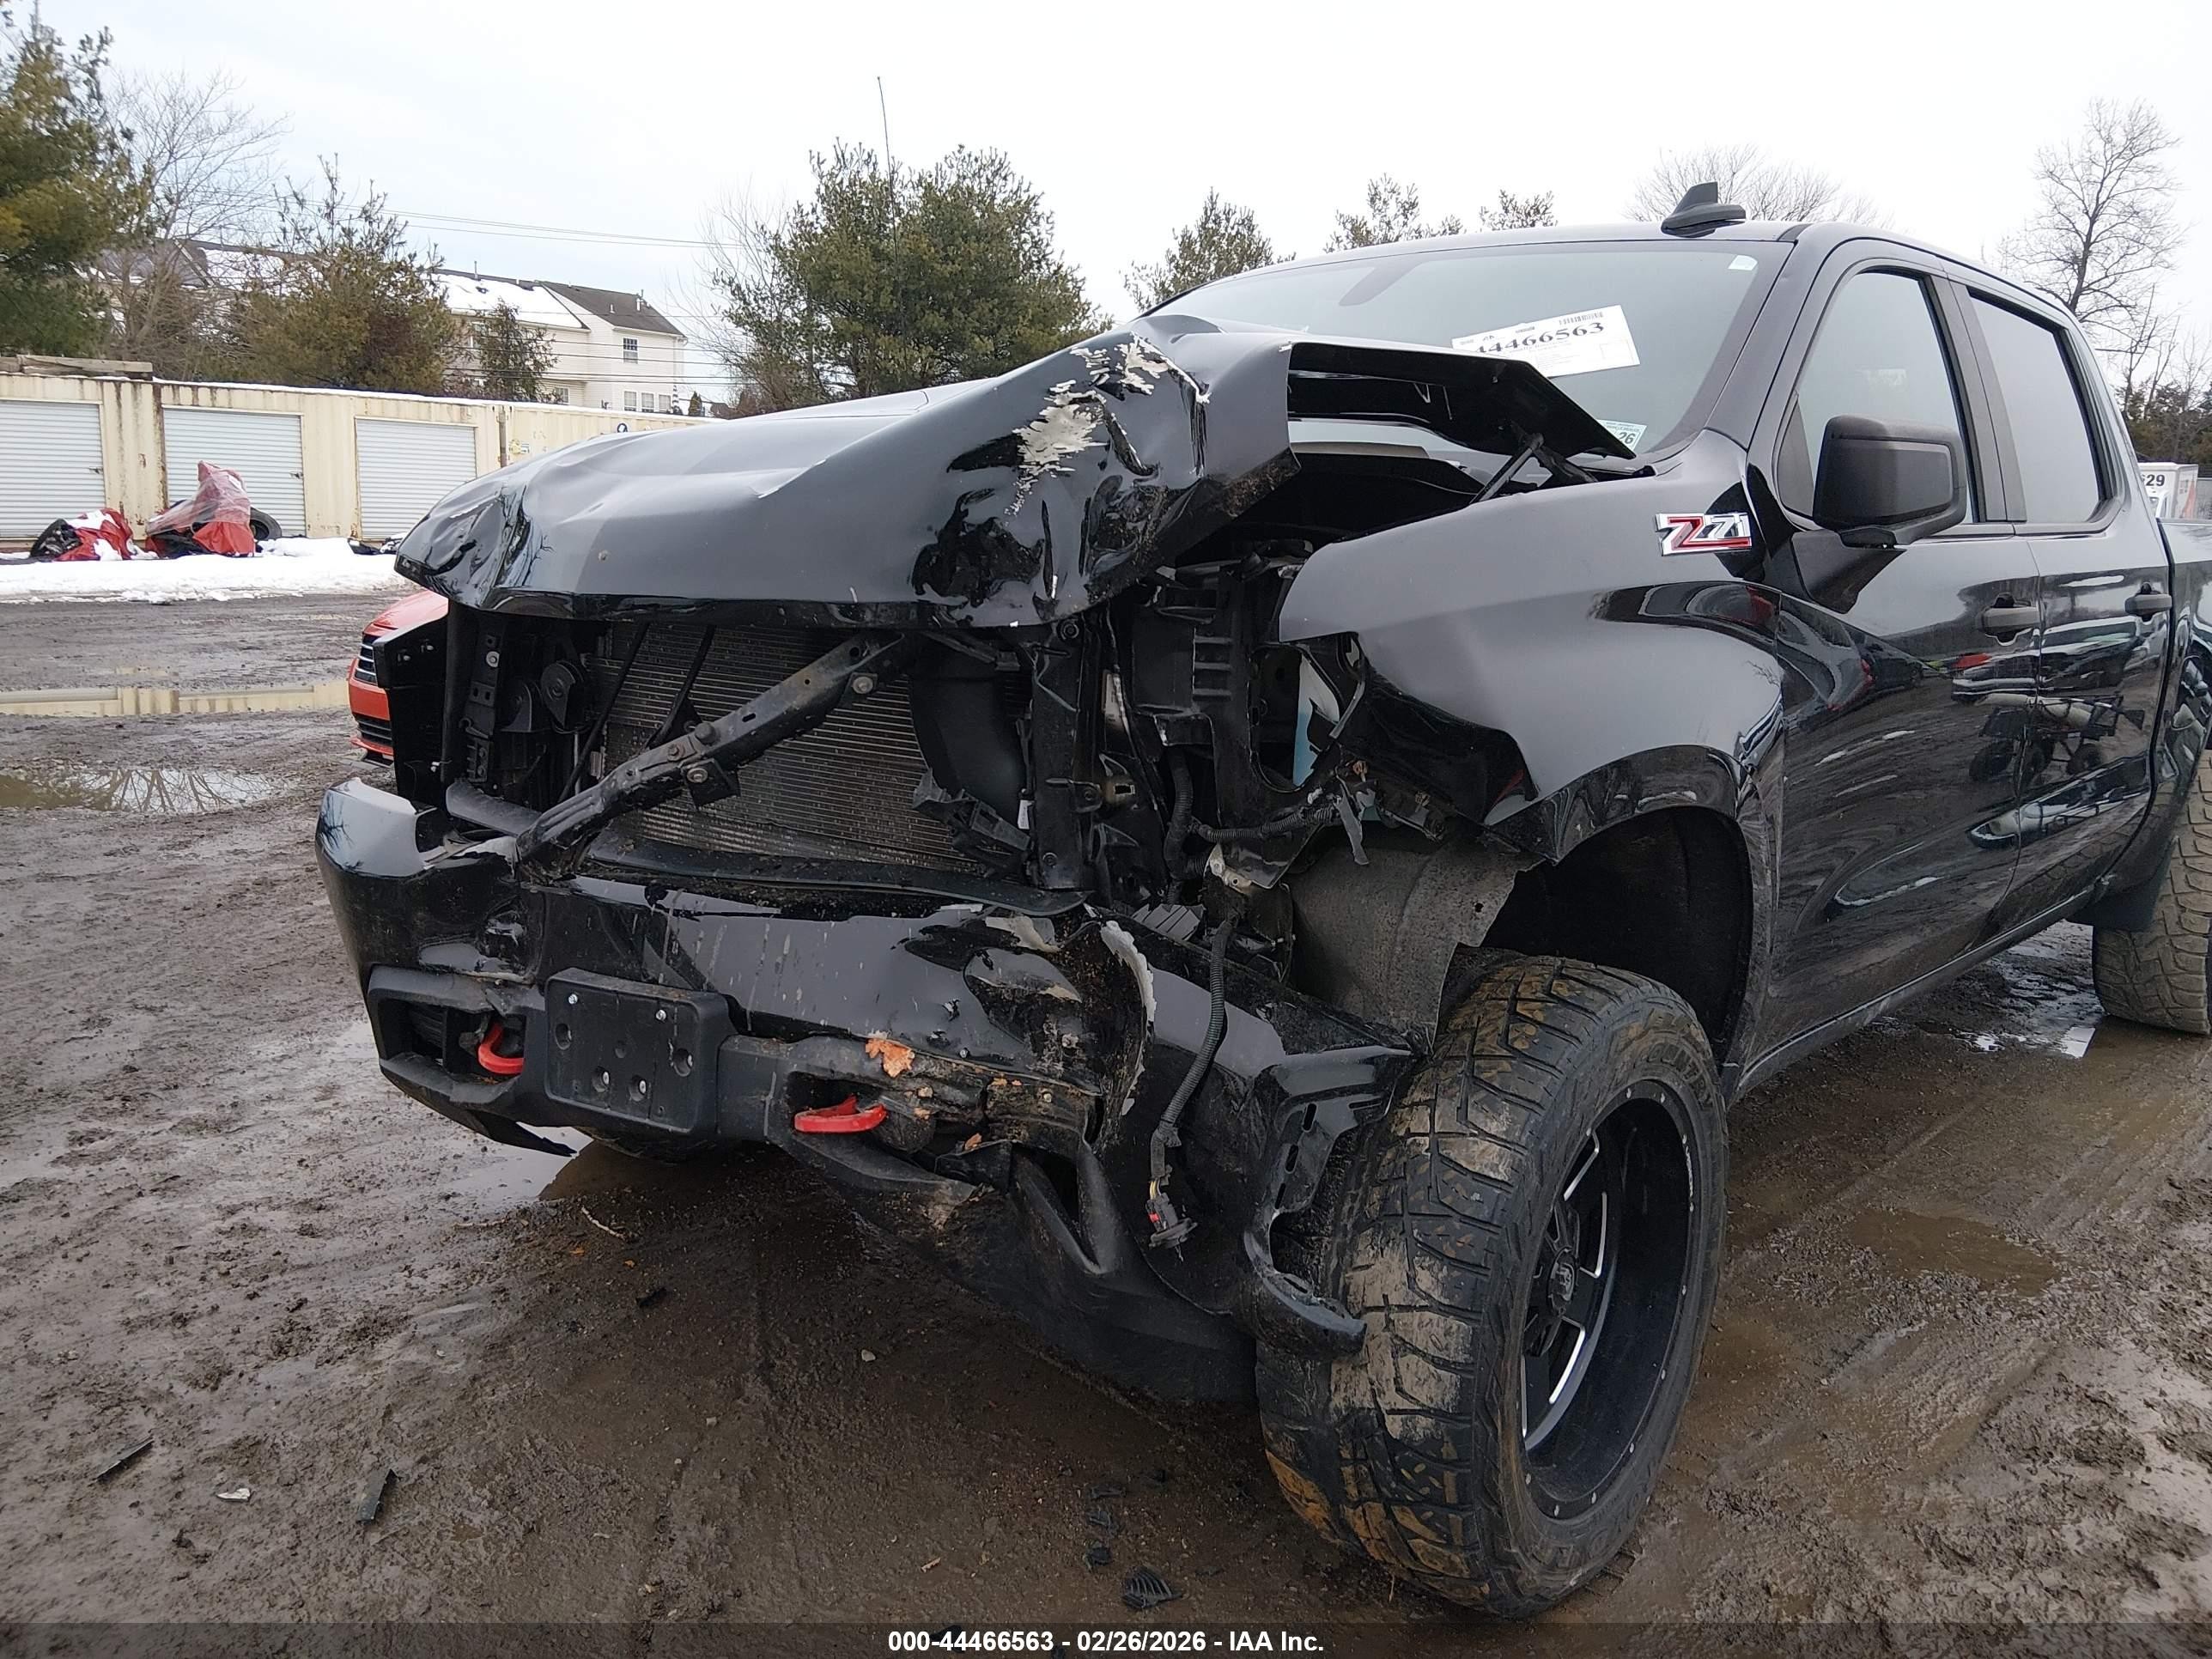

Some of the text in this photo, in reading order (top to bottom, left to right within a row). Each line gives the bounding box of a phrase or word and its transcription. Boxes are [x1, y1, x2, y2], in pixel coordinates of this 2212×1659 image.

[1618, 431, 1636, 445] 26
[2142, 473, 2166, 487] 29
[1656, 513, 1753, 556] Z71
